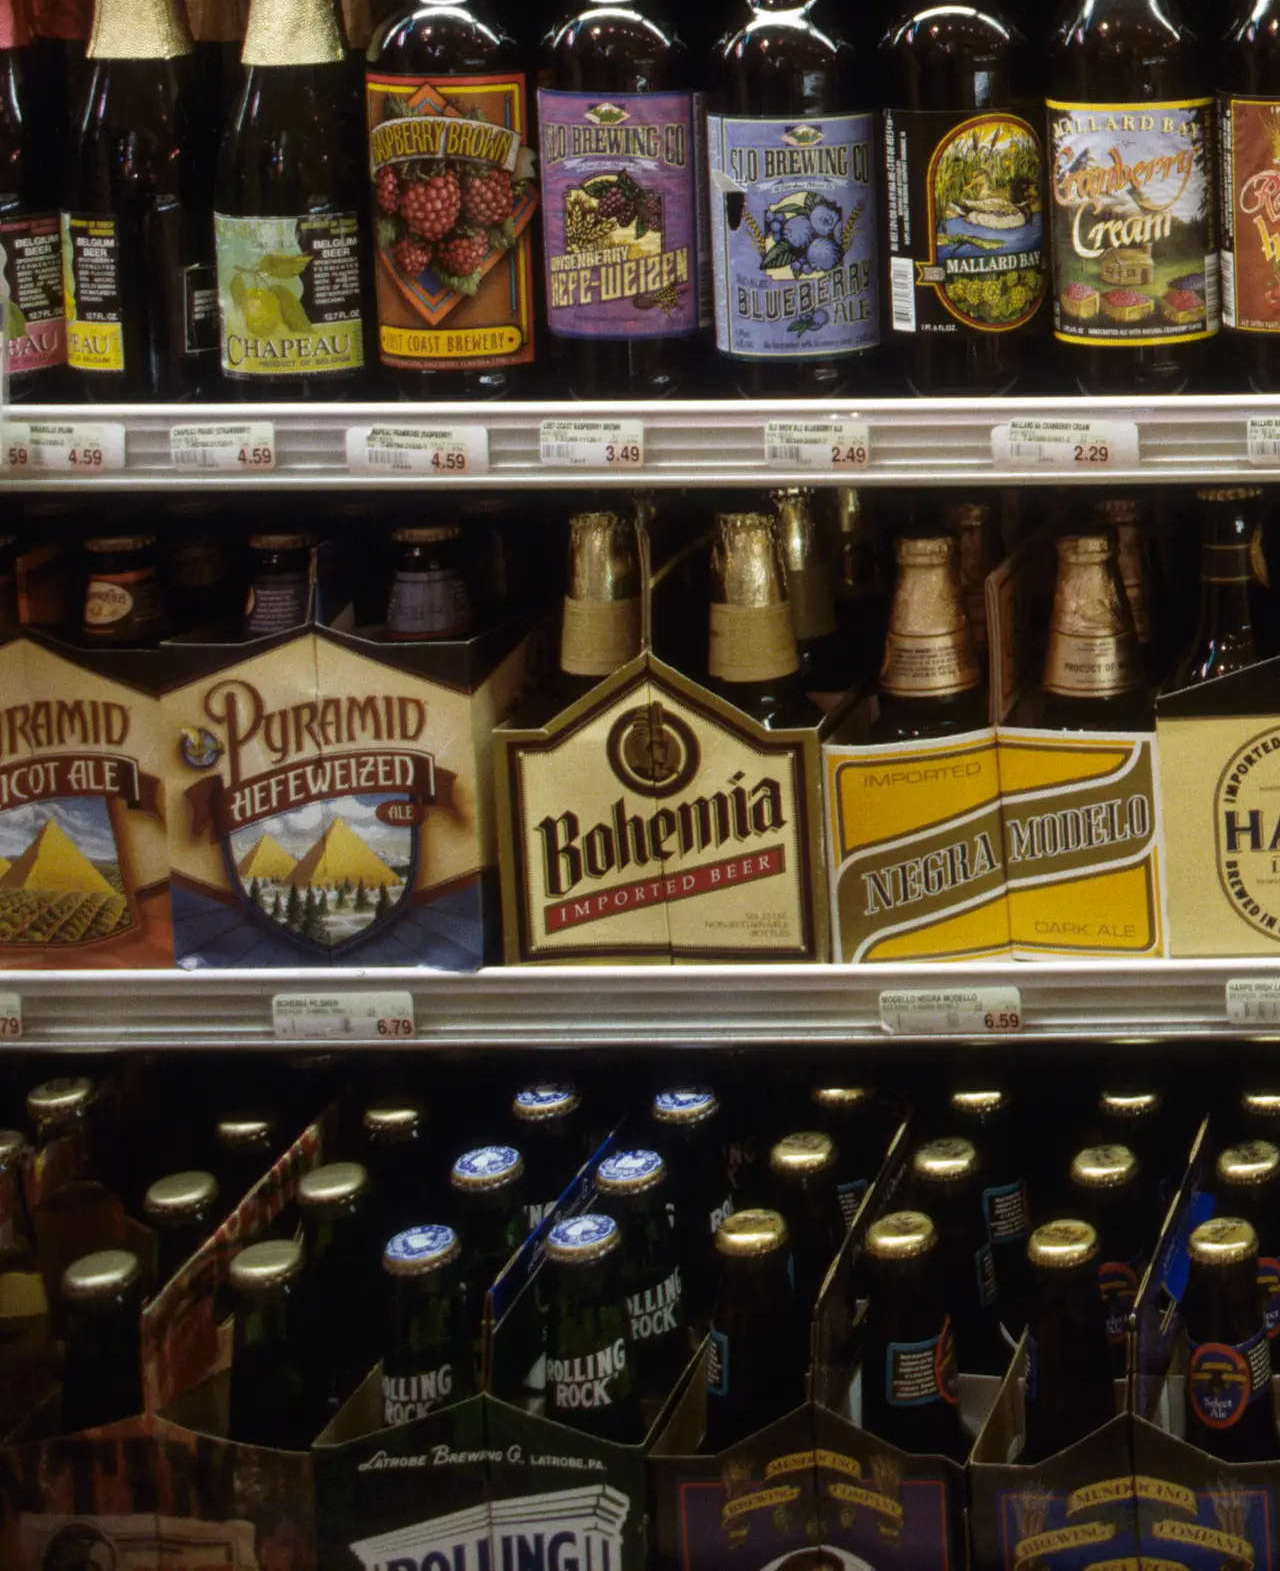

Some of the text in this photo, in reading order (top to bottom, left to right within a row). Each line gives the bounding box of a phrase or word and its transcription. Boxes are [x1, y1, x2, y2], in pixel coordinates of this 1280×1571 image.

[313, 237, 358, 249] BELGIUM
[1073, 206, 1173, 259] Cream
[322, 247, 351, 258] BEER
[946, 253, 1040, 275] MALLARD BAY
[737, 259, 871, 320] BLUEBERRY
[832, 300, 871, 324] ALE
[226, 334, 352, 365] CHAPEAU
[238, 447, 272, 466] 4.59
[1074, 444, 1109, 463] 2.29
[863, 762, 982, 788] IMPORTED
[387, 805, 415, 819] ALE
[534, 771, 788, 899] Bohemia
[863, 793, 1150, 916] NEGRA MODELO
[559, 853, 773, 924] IMPORTED BEER
[1034, 919, 1137, 938] DARK ALE
[556, 1372, 613, 1408] ROCK
